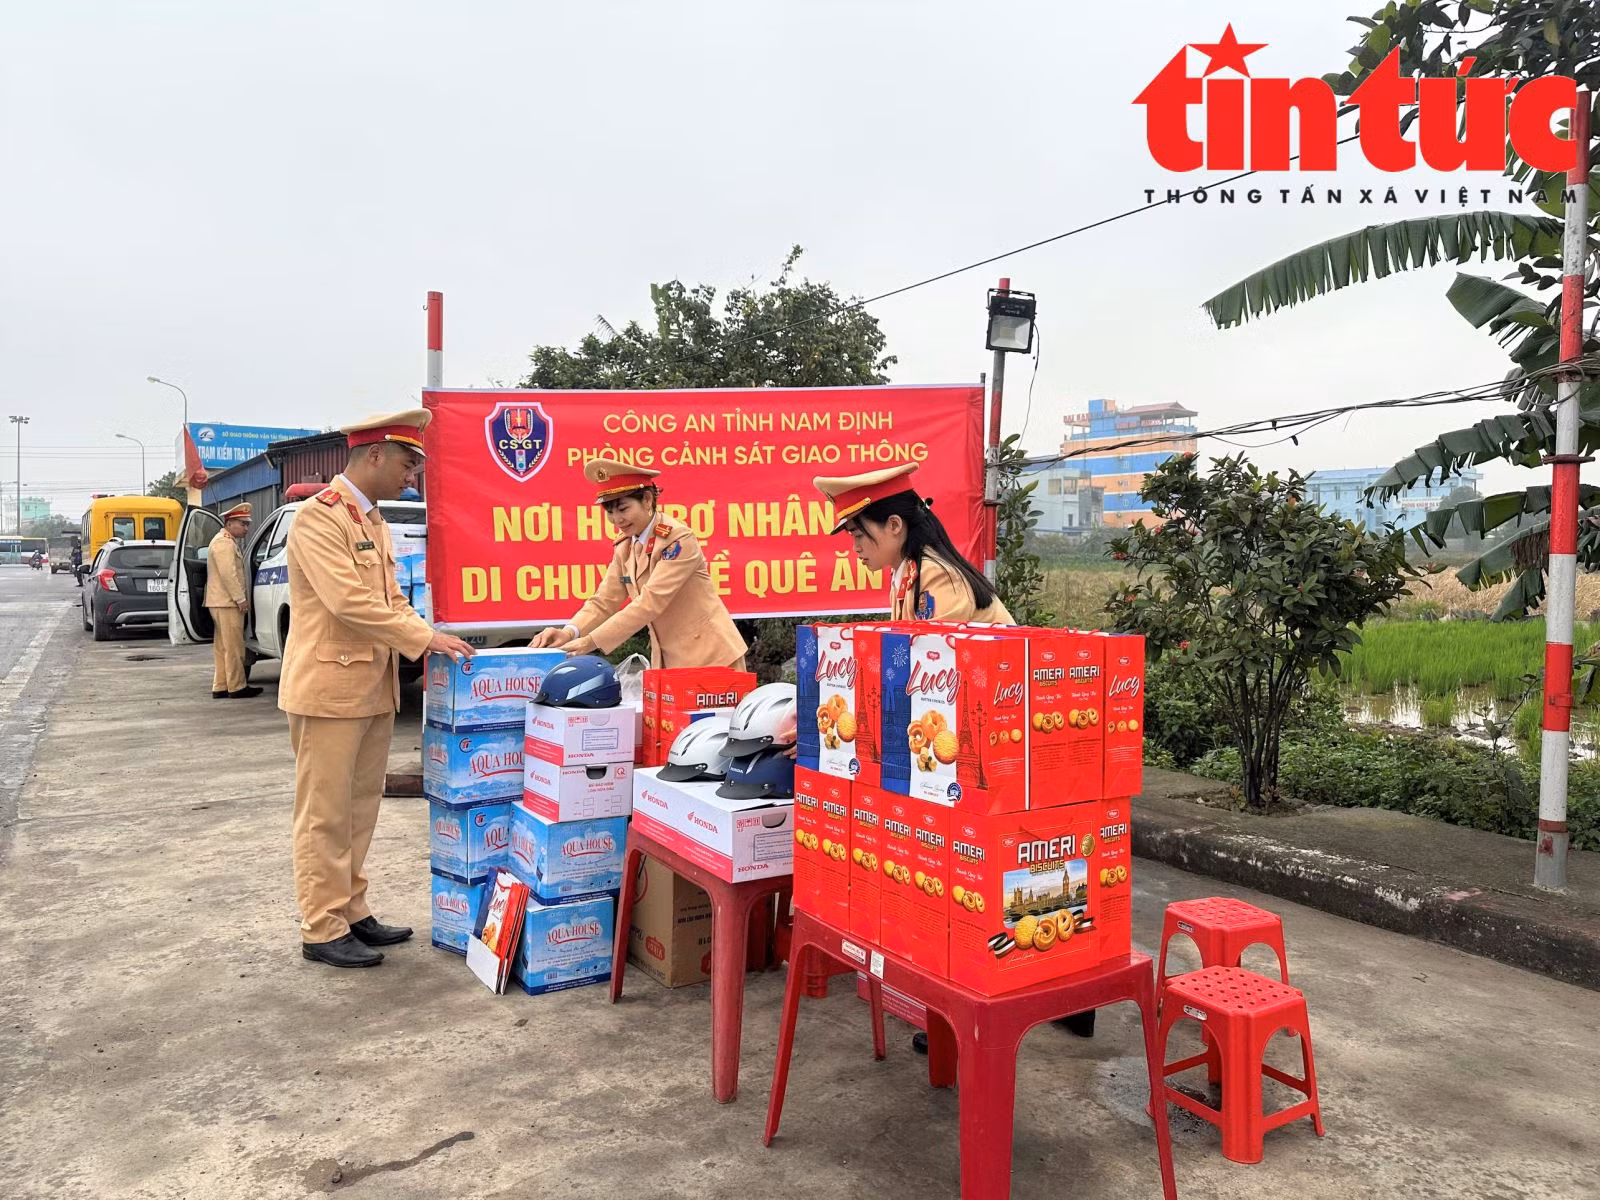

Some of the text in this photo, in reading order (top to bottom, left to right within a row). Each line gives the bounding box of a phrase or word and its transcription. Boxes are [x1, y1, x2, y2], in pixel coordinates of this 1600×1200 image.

[603, 407, 893, 435] CÔNG AN TỈNH NAM ĐỊNH
[499, 438, 543, 450] CSGT
[660, 441, 727, 465] CẢNH
[734, 441, 775, 465] SÁT
[782, 444, 841, 464] GIAO
[847, 438, 929, 463] THÔNG
[493, 502, 563, 542] NƠI
[727, 493, 835, 538] NHÂN
[461, 566, 502, 603] DI
[745, 551, 818, 598] QUÊ
[816, 649, 858, 690] Lucy
[1033, 667, 1065, 681] AMERI
[1069, 665, 1100, 679] AMERI
[471, 676, 541, 700] AQUA HOUSE
[906, 660, 962, 705] Lucy
[1108, 674, 1140, 697] Lucy
[696, 691, 738, 706] AMERI
[993, 681, 1024, 705] Lucy
[469, 754, 500, 776] AQUA
[647, 794, 668, 809] HONDA
[795, 792, 819, 809] AMERI
[822, 800, 847, 817] AMERI
[694, 816, 718, 834] HONDA
[853, 808, 878, 826] AMERI
[884, 818, 911, 837] AMERI
[562, 837, 614, 856] AQUA HOUSE
[915, 828, 945, 848] AMERI
[953, 840, 985, 862] AMERI
[1017, 834, 1076, 865] AMERI
[737, 863, 769, 872] HONDA
[1029, 859, 1065, 874] BISCUITS
[546, 921, 600, 945] AQUA HOUSE
